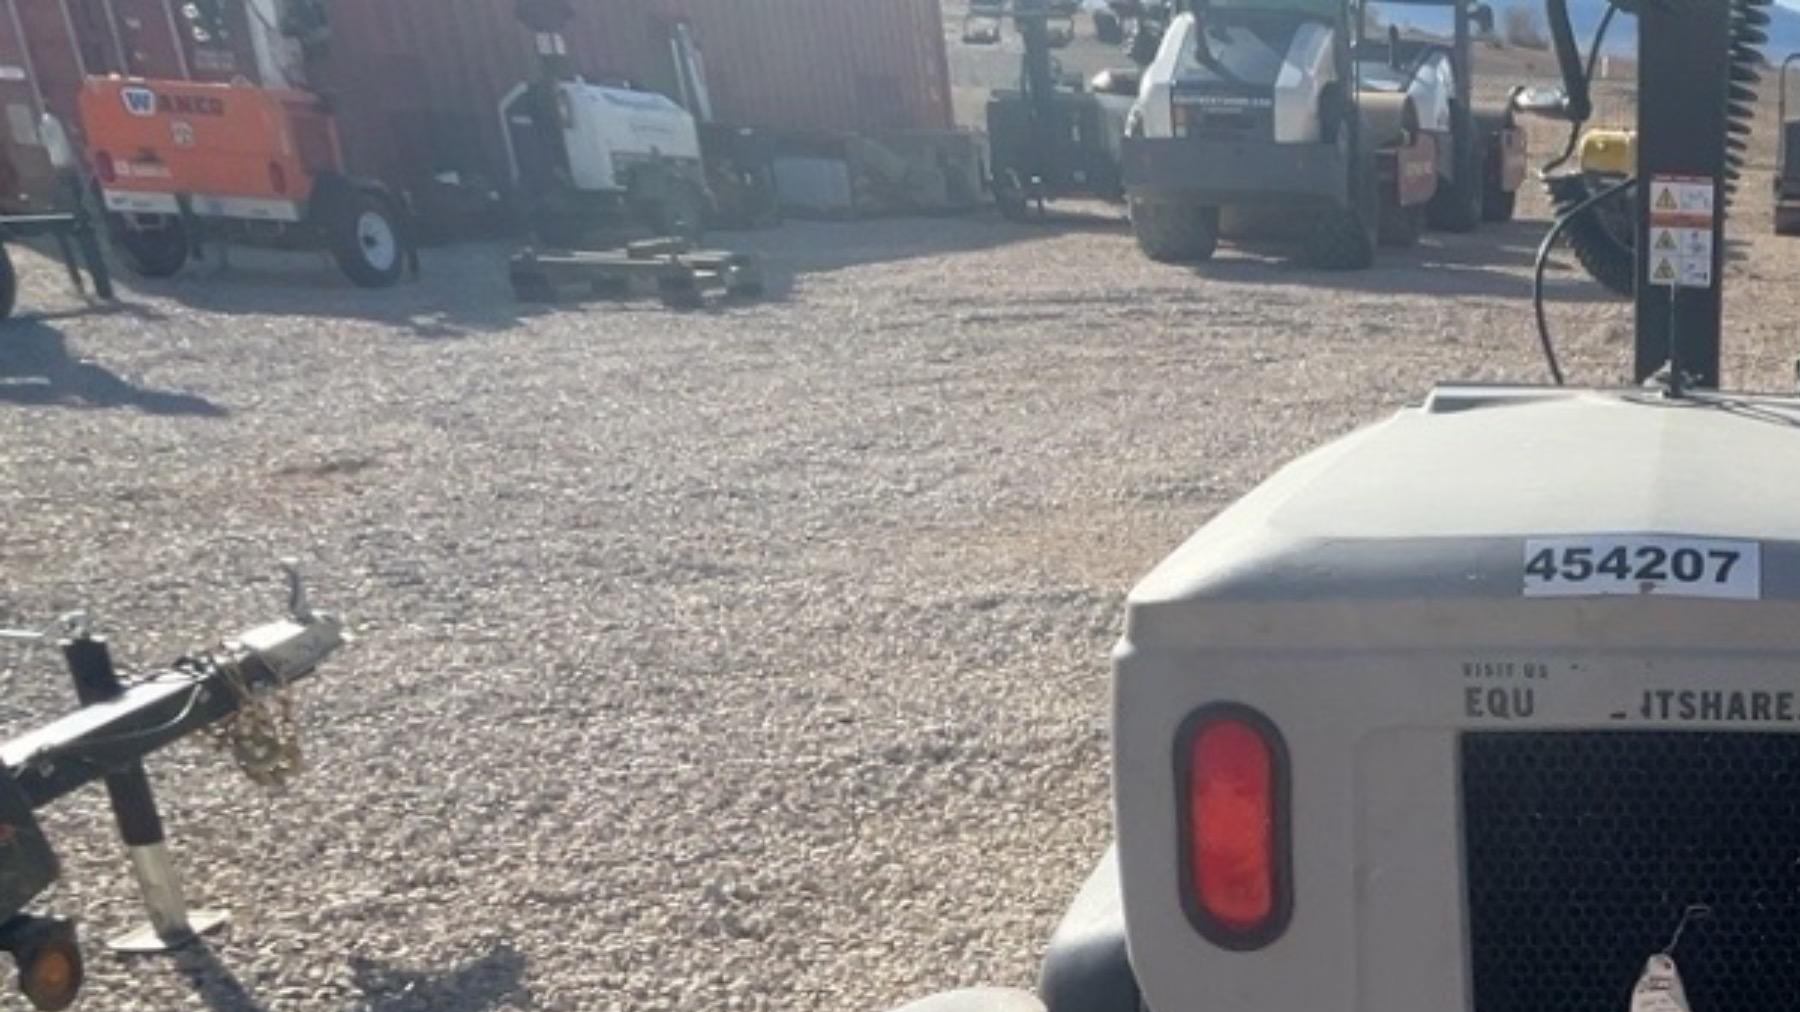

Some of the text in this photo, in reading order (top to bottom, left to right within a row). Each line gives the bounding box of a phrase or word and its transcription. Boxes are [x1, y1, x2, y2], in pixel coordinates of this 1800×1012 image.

[1525, 545, 1742, 583] 454207
[1463, 662, 1549, 679] VISIT US
